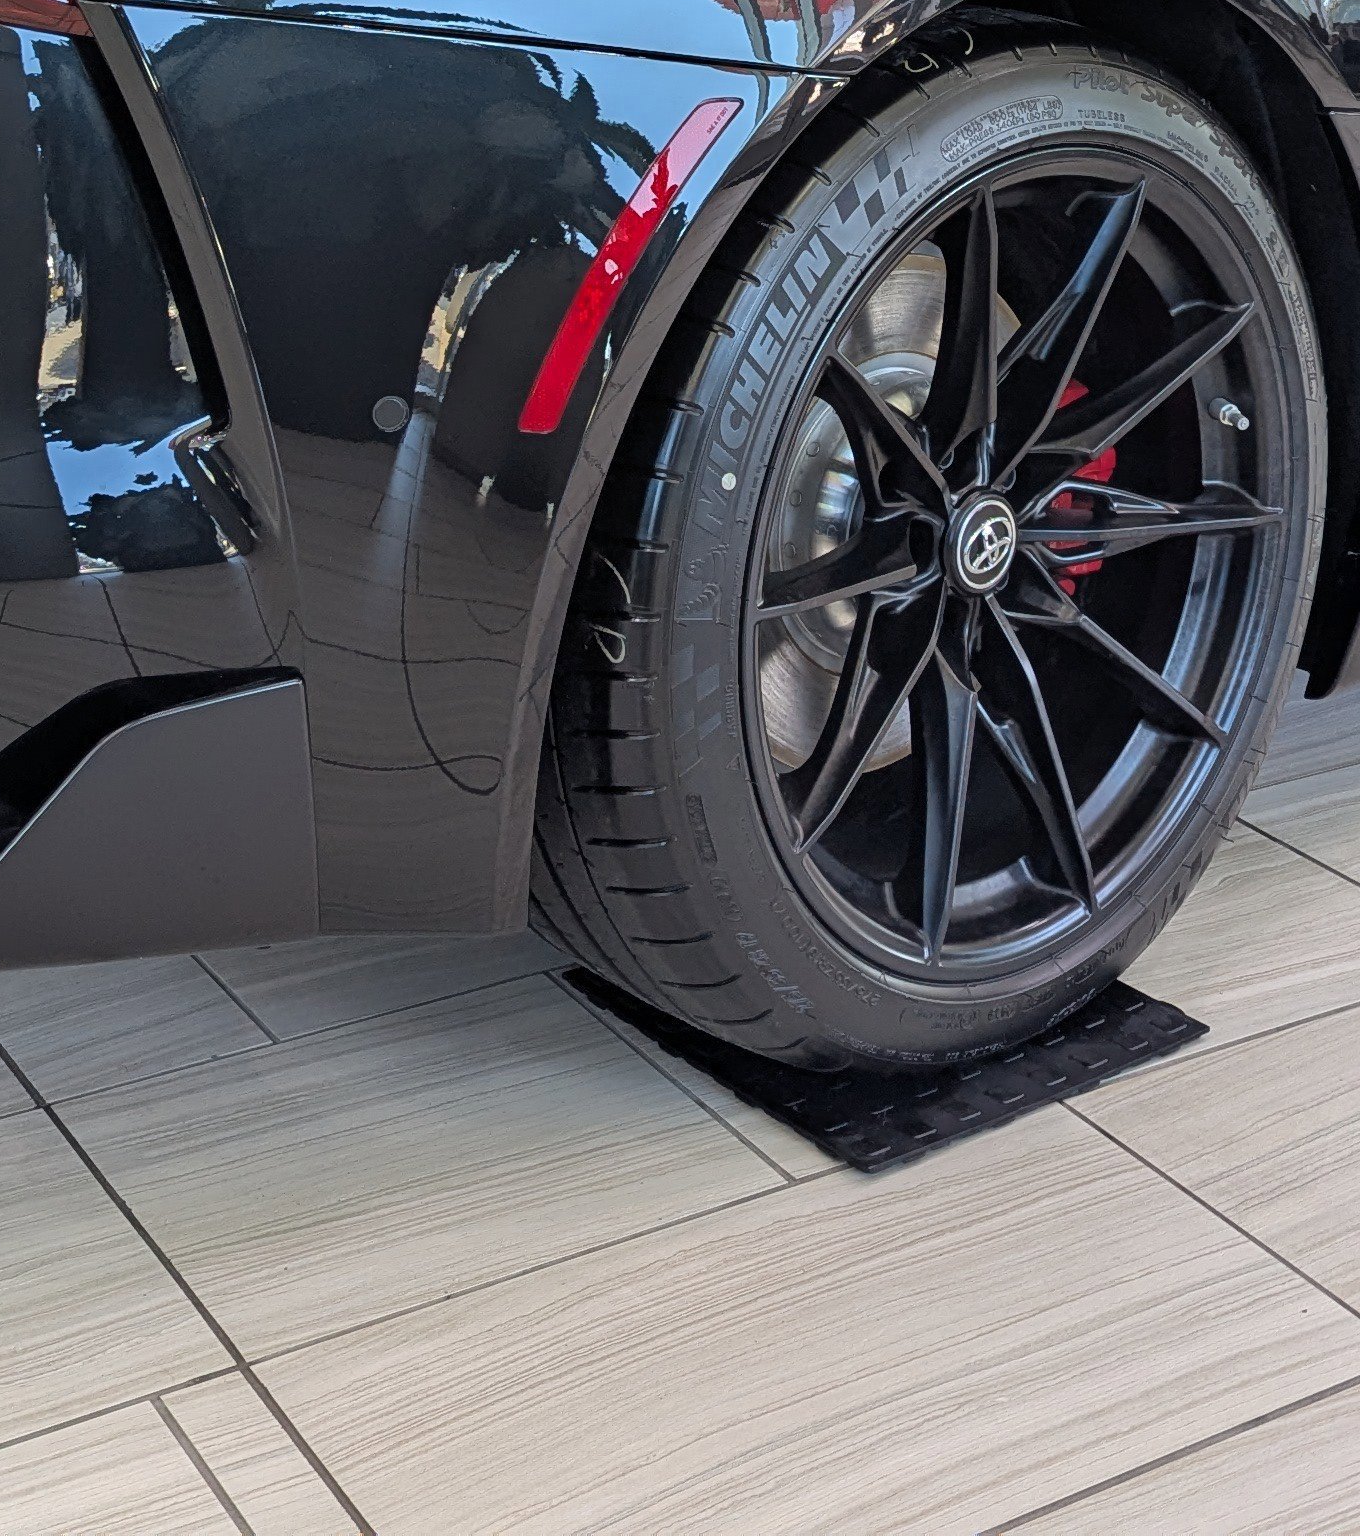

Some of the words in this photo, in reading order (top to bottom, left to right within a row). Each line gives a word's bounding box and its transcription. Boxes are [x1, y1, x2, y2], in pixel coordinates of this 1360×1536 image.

[1064, 65, 1130, 96] Pilot
[1139, 81, 1203, 128] Super
[1208, 130, 1260, 192] Sport
[1077, 109, 1126, 123] TUBELESS
[695, 231, 832, 537] MICHELIN
